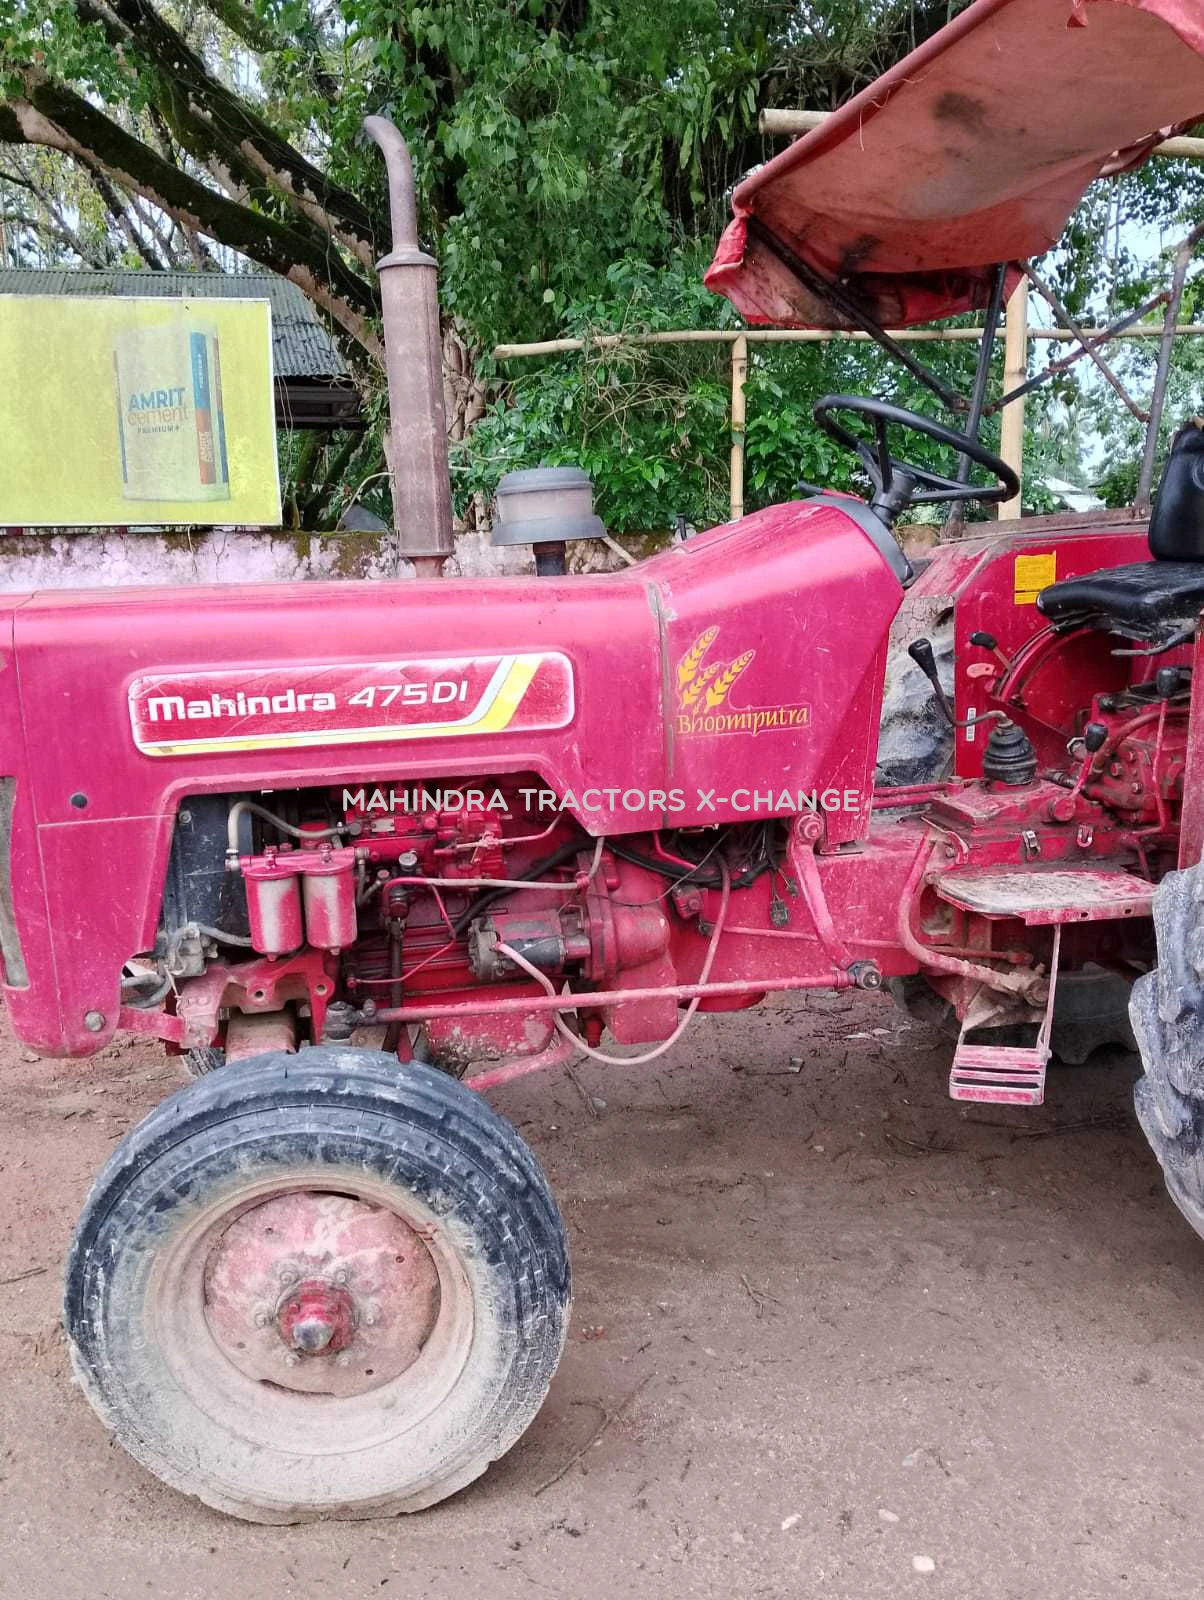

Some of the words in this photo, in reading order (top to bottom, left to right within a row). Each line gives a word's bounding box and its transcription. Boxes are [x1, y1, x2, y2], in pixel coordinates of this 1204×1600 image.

[129, 387, 186, 411] AMRIT
[127, 404, 189, 426] cement
[148, 689, 336, 721] Mahindra
[677, 706, 809, 736] Bhoomiputra
